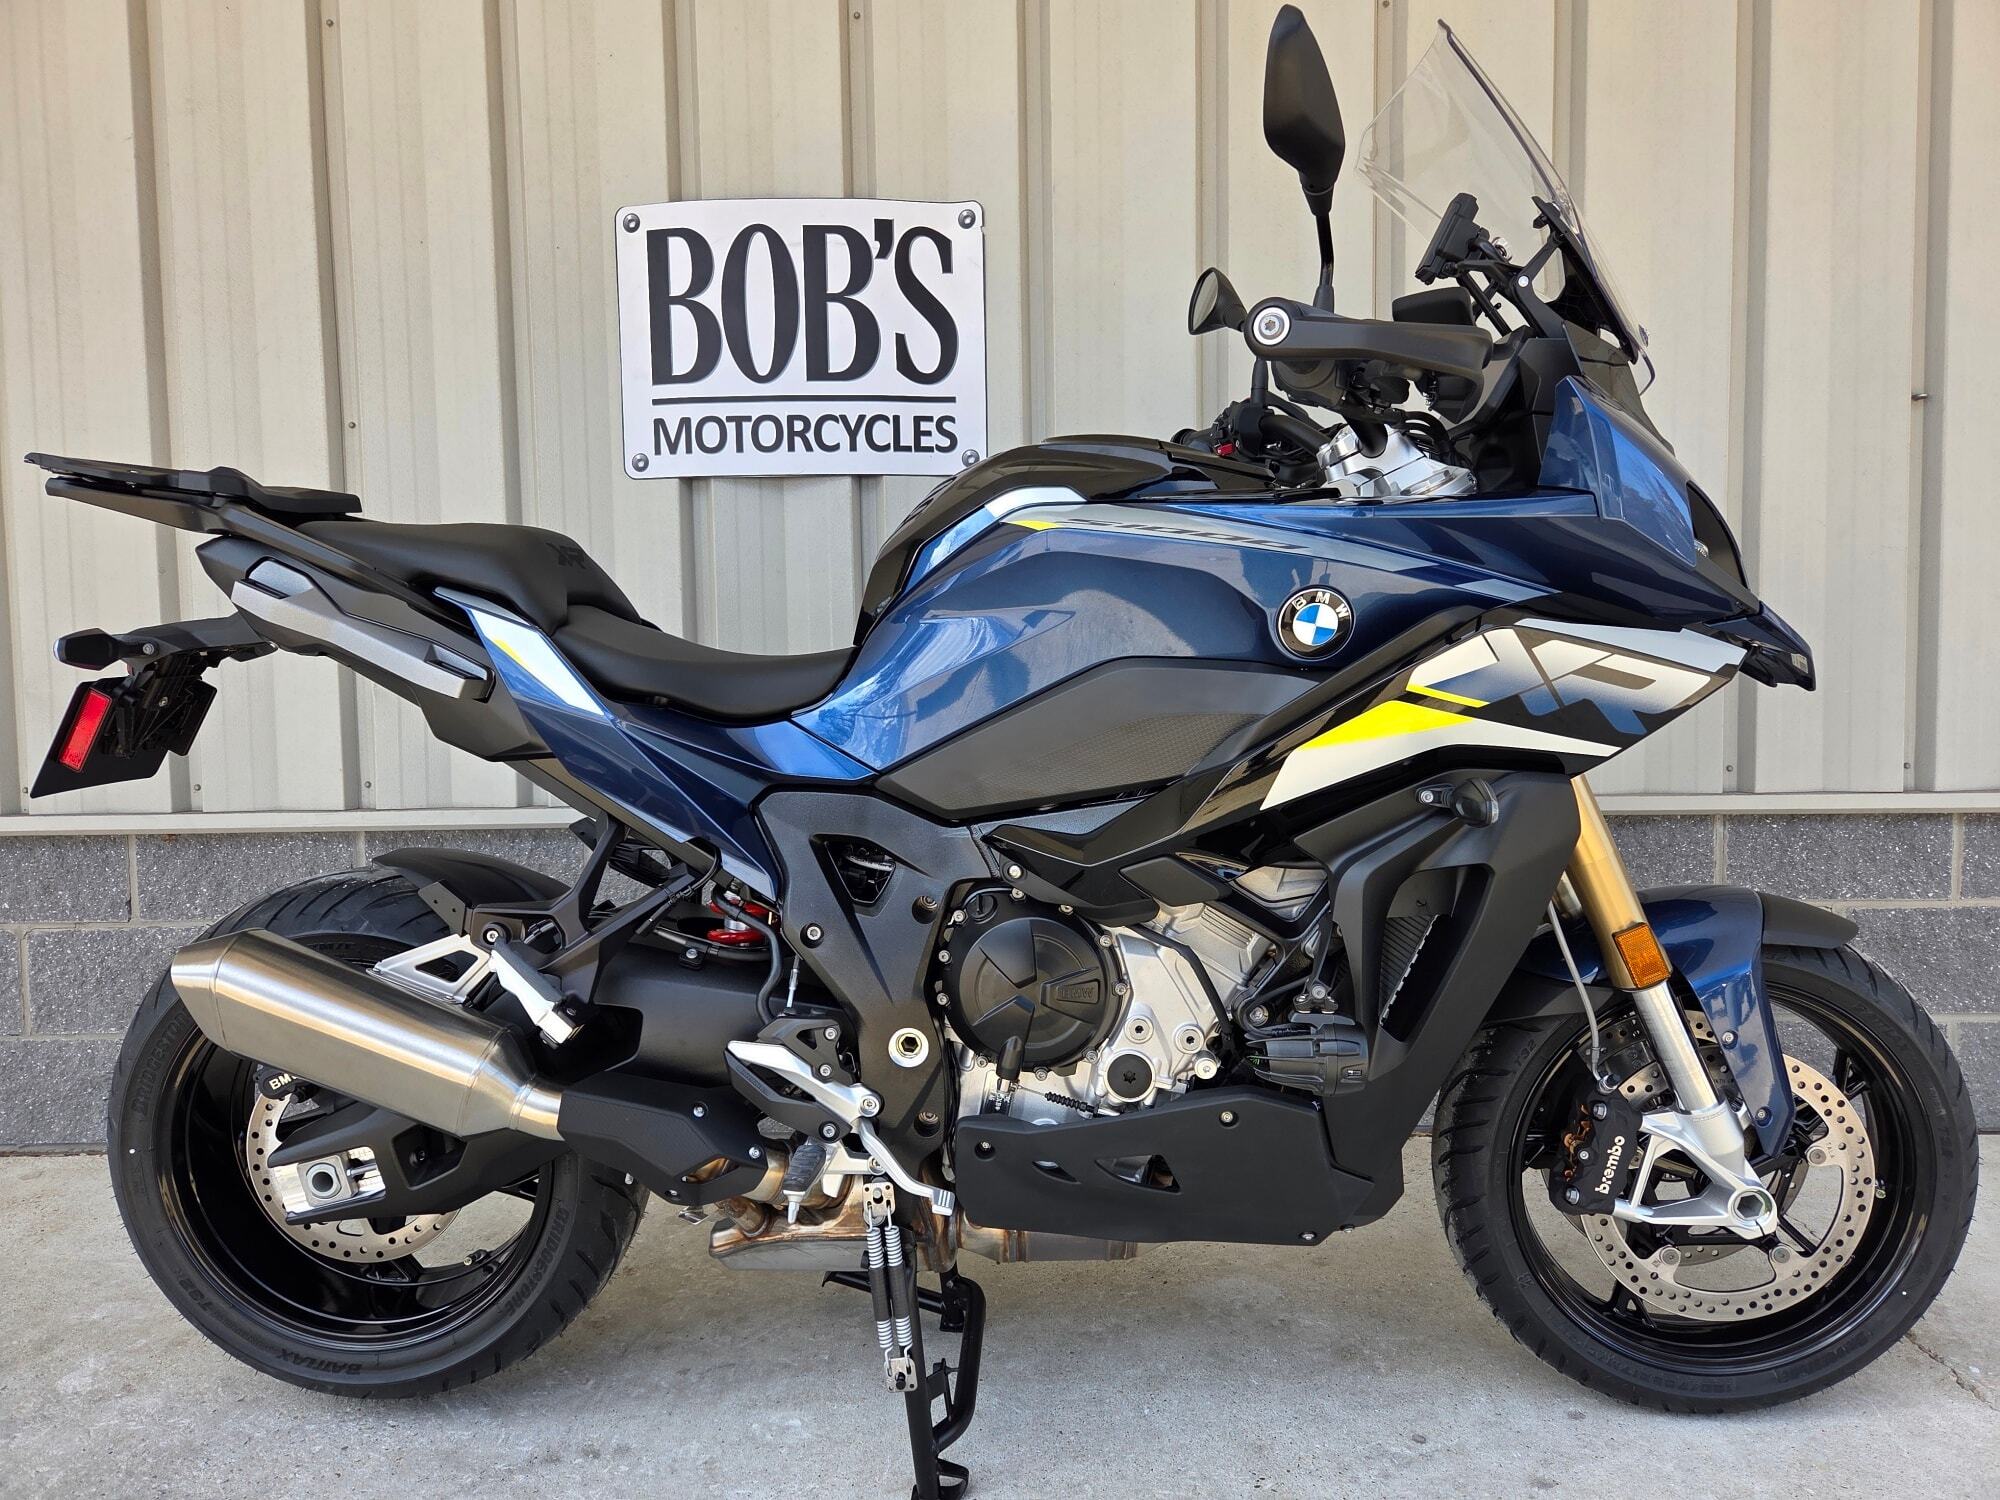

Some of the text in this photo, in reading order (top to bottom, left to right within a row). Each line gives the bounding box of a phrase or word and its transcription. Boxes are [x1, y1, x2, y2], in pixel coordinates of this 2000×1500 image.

[646, 218, 959, 386] BOB'S
[653, 413, 958, 456] MOTORCYCLES
[1292, 591, 1349, 618] BMW
[269, 1073, 297, 1090] BM
[1594, 1135, 1625, 1195] brembo
